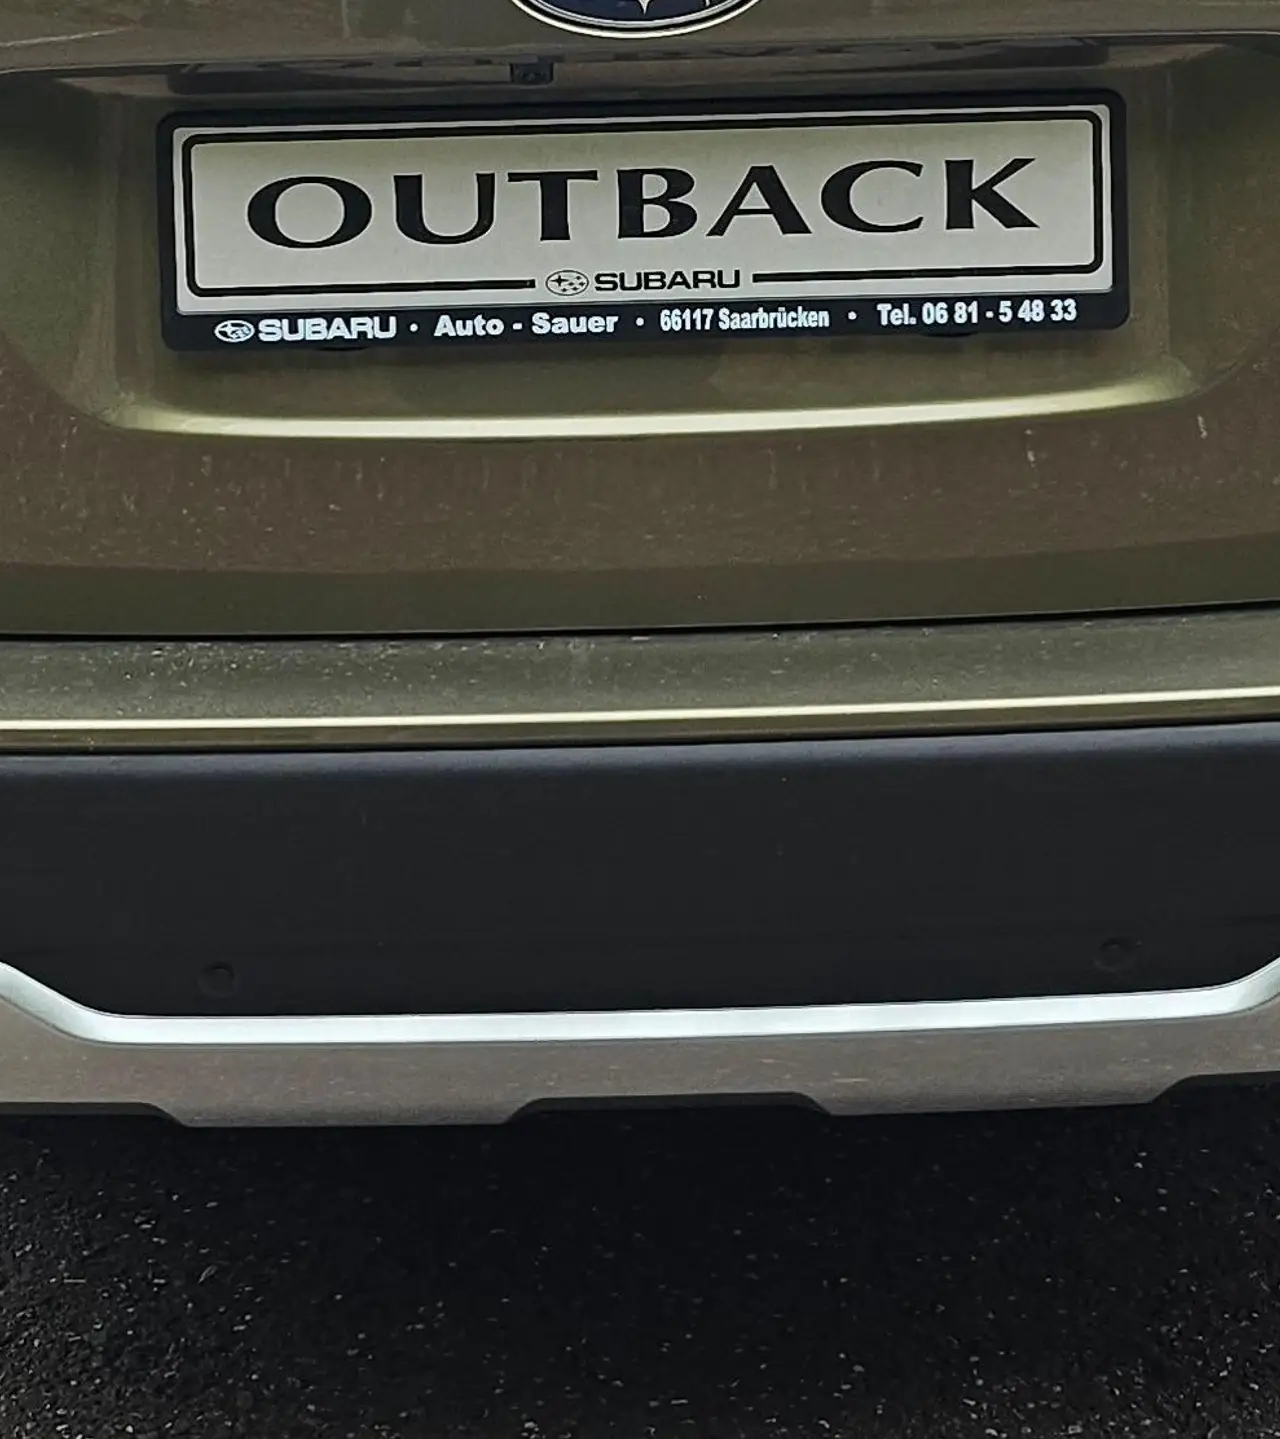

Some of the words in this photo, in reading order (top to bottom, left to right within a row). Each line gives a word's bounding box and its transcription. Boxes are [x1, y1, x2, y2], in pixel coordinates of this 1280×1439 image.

[246, 157, 1037, 250] OUTBACK
[594, 269, 740, 292] SUBARU
[258, 316, 398, 342] SUBARU
[434, 314, 505, 337] Auto
[531, 311, 620, 335] Sauer
[660, 308, 713, 331] 66117
[718, 306, 830, 330] Saarbrücken
[876, 303, 917, 326] Tel.
[922, 302, 949, 325] 06
[953, 300, 979, 324] 81
[999, 300, 1012, 323] 5
[1017, 299, 1045, 322] 48
[1050, 298, 1077, 321] 33
